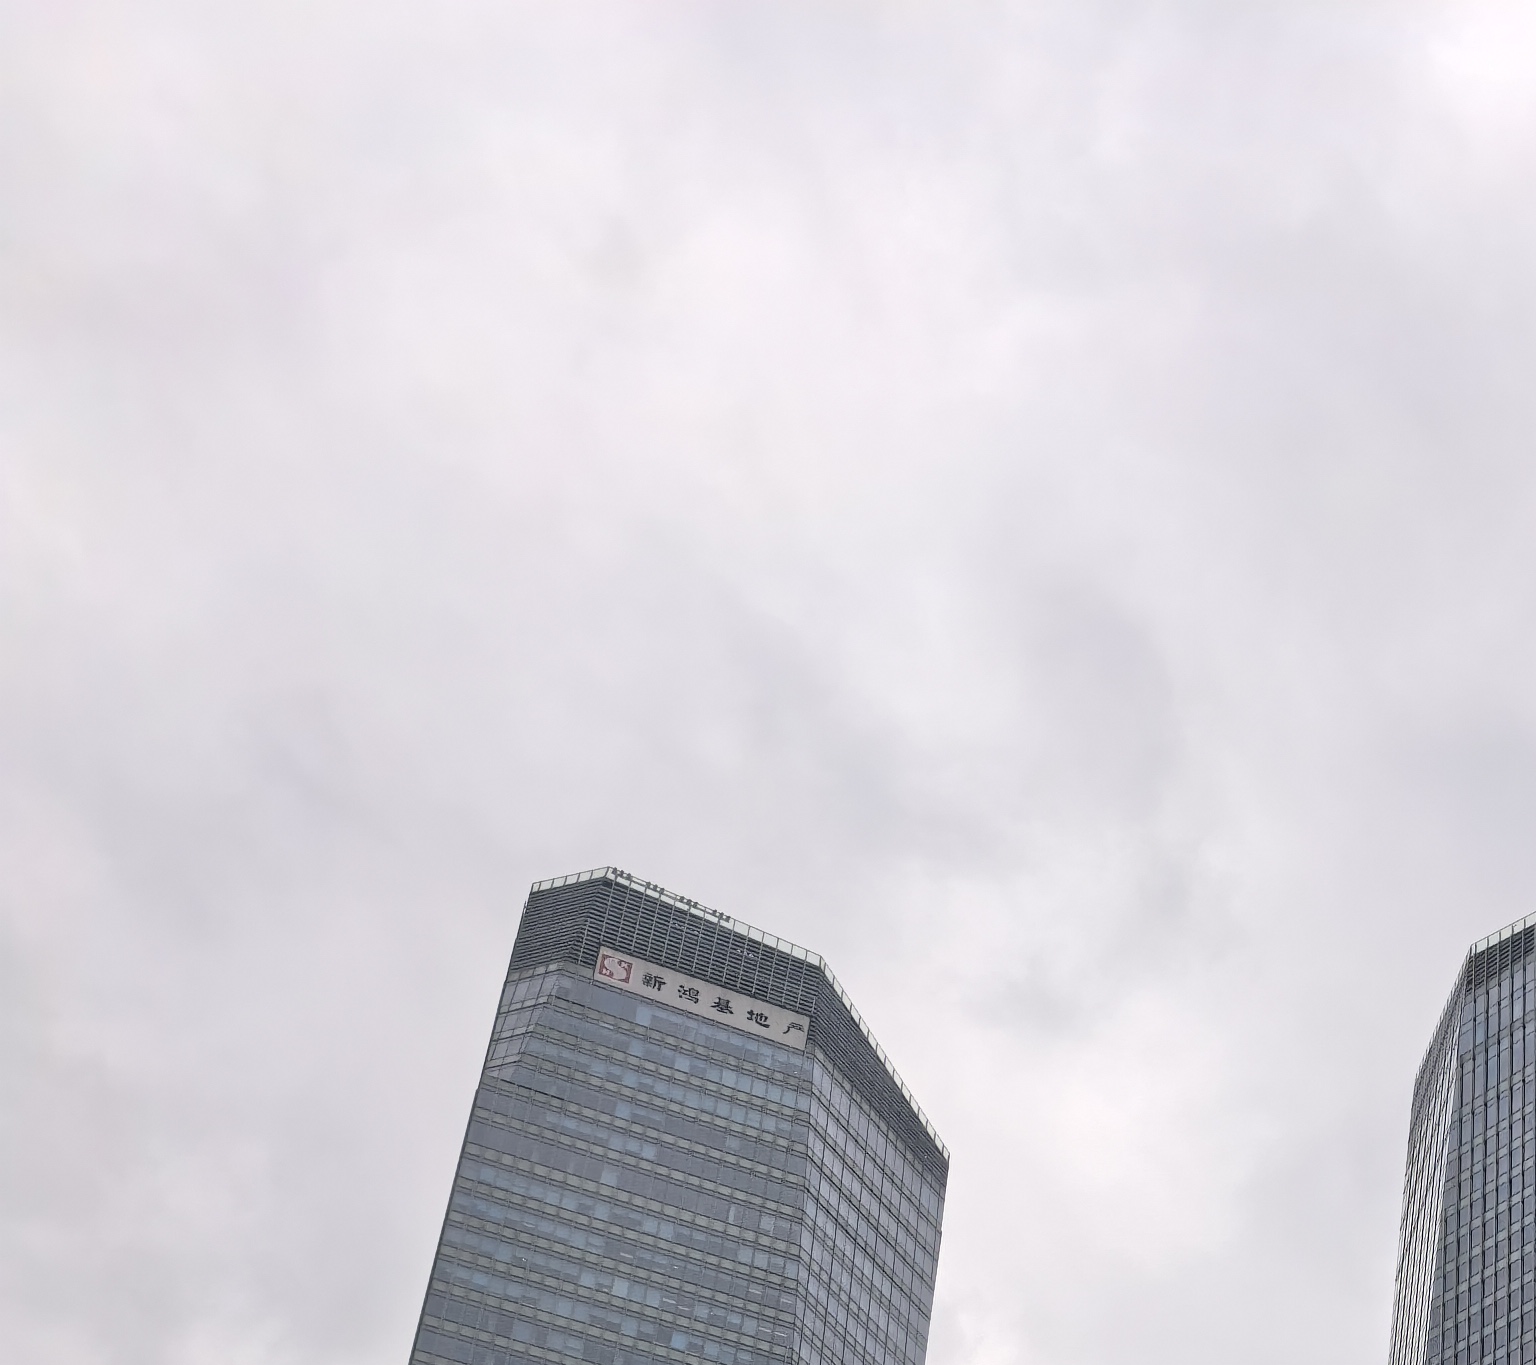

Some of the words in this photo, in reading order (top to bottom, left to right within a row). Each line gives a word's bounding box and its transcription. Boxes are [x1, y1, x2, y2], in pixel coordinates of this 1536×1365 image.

[641, 972, 804, 1035] 新鸿基地产
